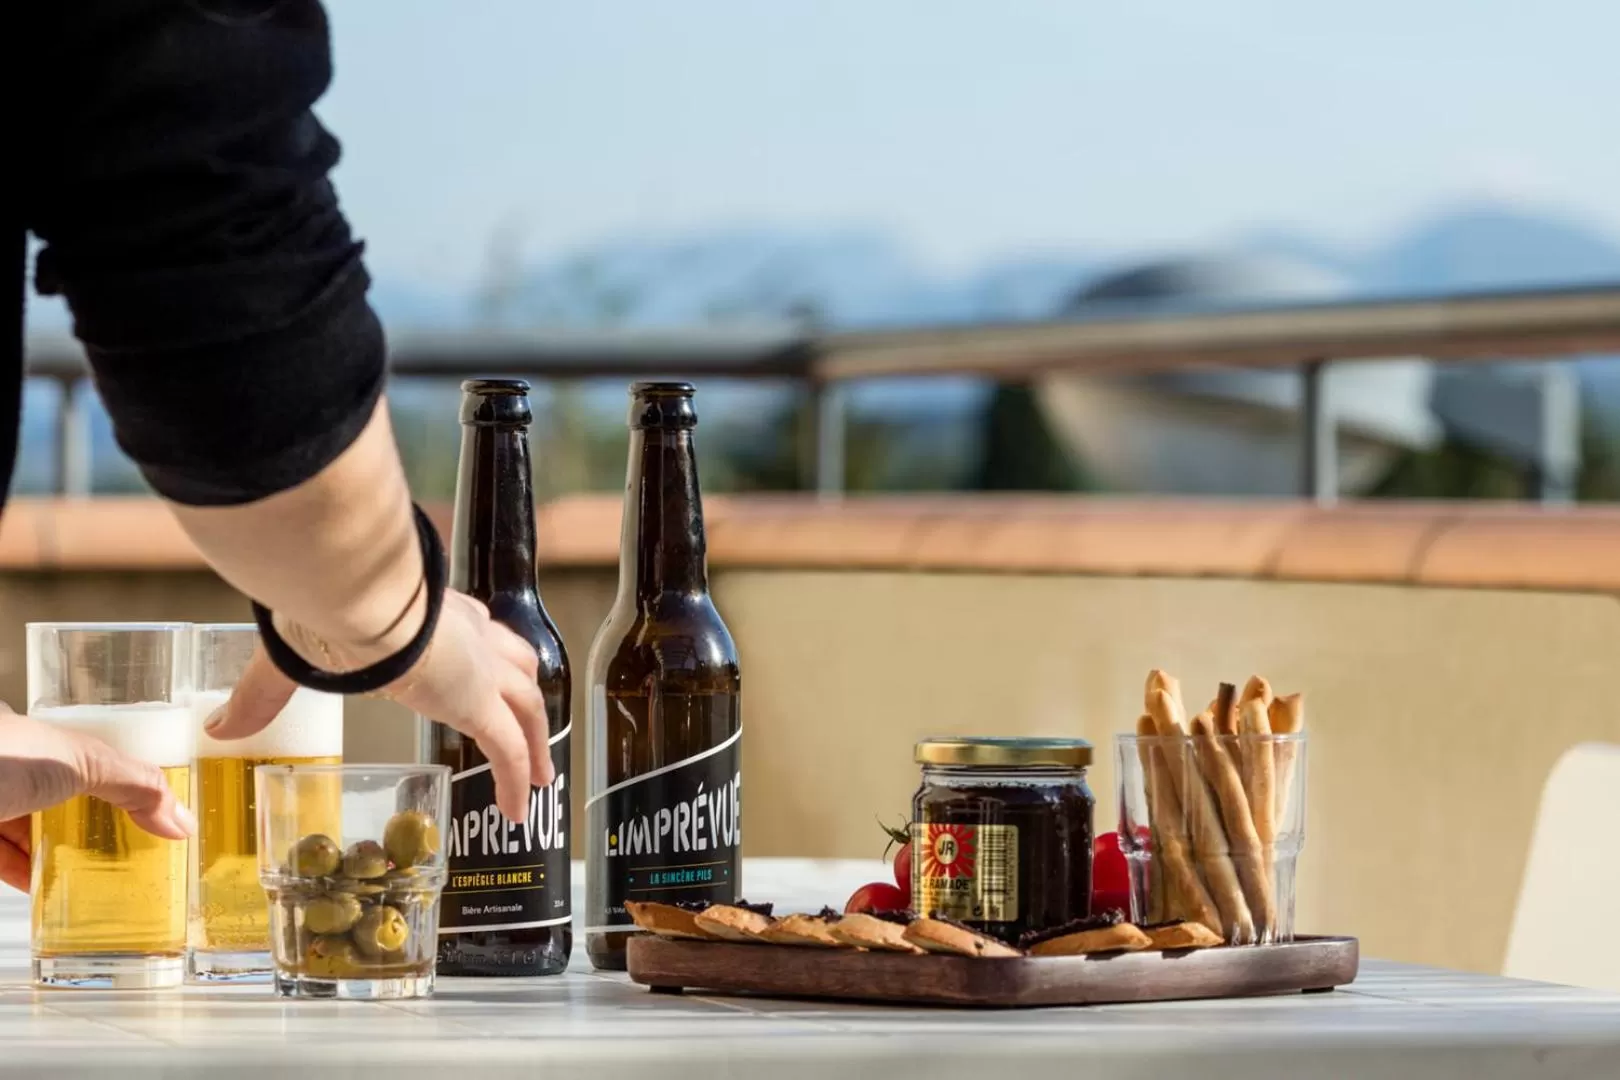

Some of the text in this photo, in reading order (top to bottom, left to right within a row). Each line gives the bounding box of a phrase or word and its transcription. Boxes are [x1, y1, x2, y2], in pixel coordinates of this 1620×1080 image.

[939, 841, 955, 856] JR
[497, 871, 532, 885] BLANCHE
[696, 869, 713, 882] PILS
[462, 904, 523, 916] Bière Artisanale
